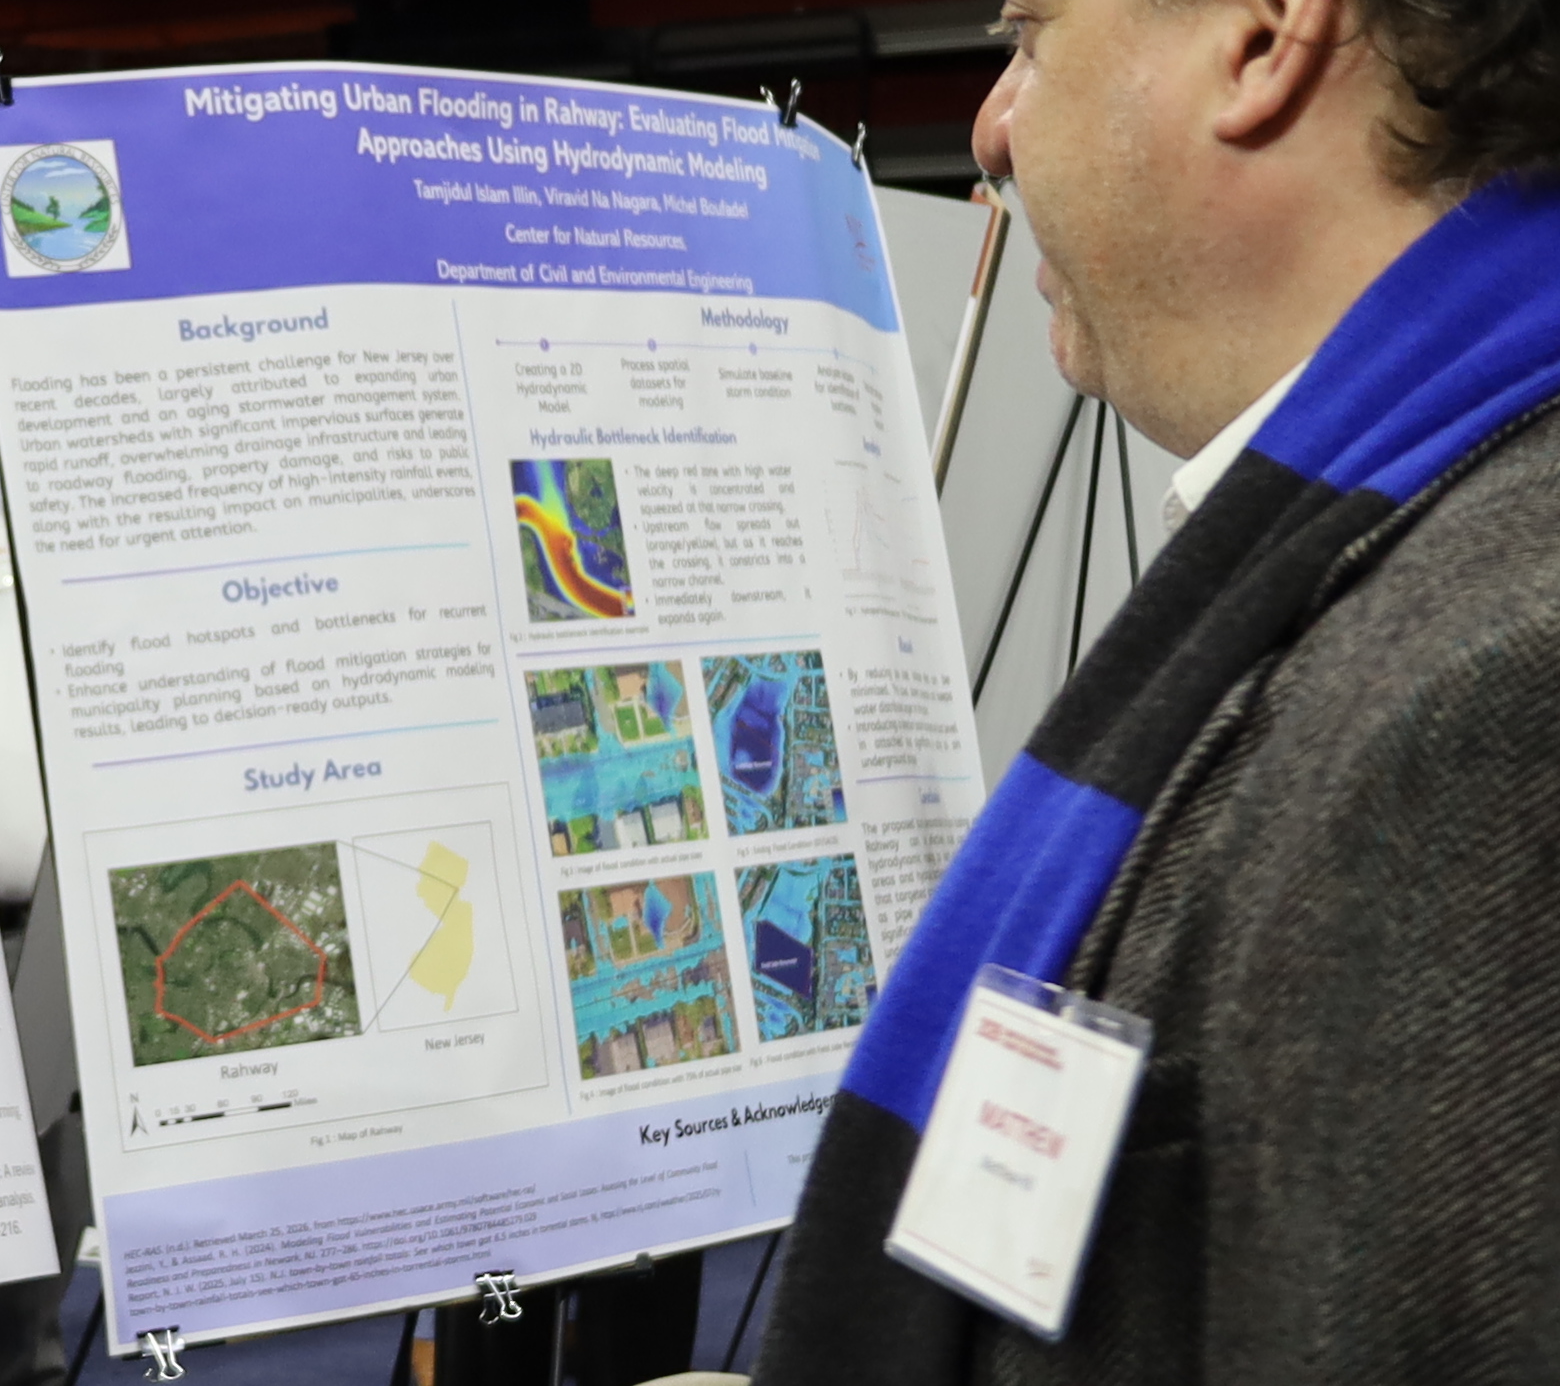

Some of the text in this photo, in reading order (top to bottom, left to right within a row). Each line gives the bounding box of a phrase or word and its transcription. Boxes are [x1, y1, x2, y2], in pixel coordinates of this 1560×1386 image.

[185, 86, 338, 122] Mitigating
[344, 85, 412, 115] Urban
[418, 90, 513, 128] Flooding
[519, 97, 538, 122] in
[545, 99, 624, 135] Rahway:
[629, 109, 718, 145] Evaluating
[723, 116, 769, 145] Flood
[357, 127, 767, 189] Approaches Using Hydrodynamic Modeling
[414, 179, 473, 202] Tamjidul
[476, 183, 509, 204] Islam
[544, 188, 589, 208] Viravid
[592, 190, 609, 208] Na
[506, 225, 549, 246] Center
[553, 225, 571, 245] for
[576, 227, 620, 247] Natural
[178, 306, 329, 342] Background
[701, 307, 788, 335] Methodology
[11, 350, 454, 393] Flooding has been a persistent challenge for New Jersey over
[530, 427, 737, 450] Hydraulic Bottleneck Identification
[222, 573, 338, 606] Objective
[244, 759, 382, 791] Study Area
[425, 1034, 484, 1050] New Jersey
[220, 1063, 278, 1079] Rahway
[640, 1125, 670, 1146] Key
[674, 1117, 728, 1138] Sources
[731, 1108, 742, 1127] &
